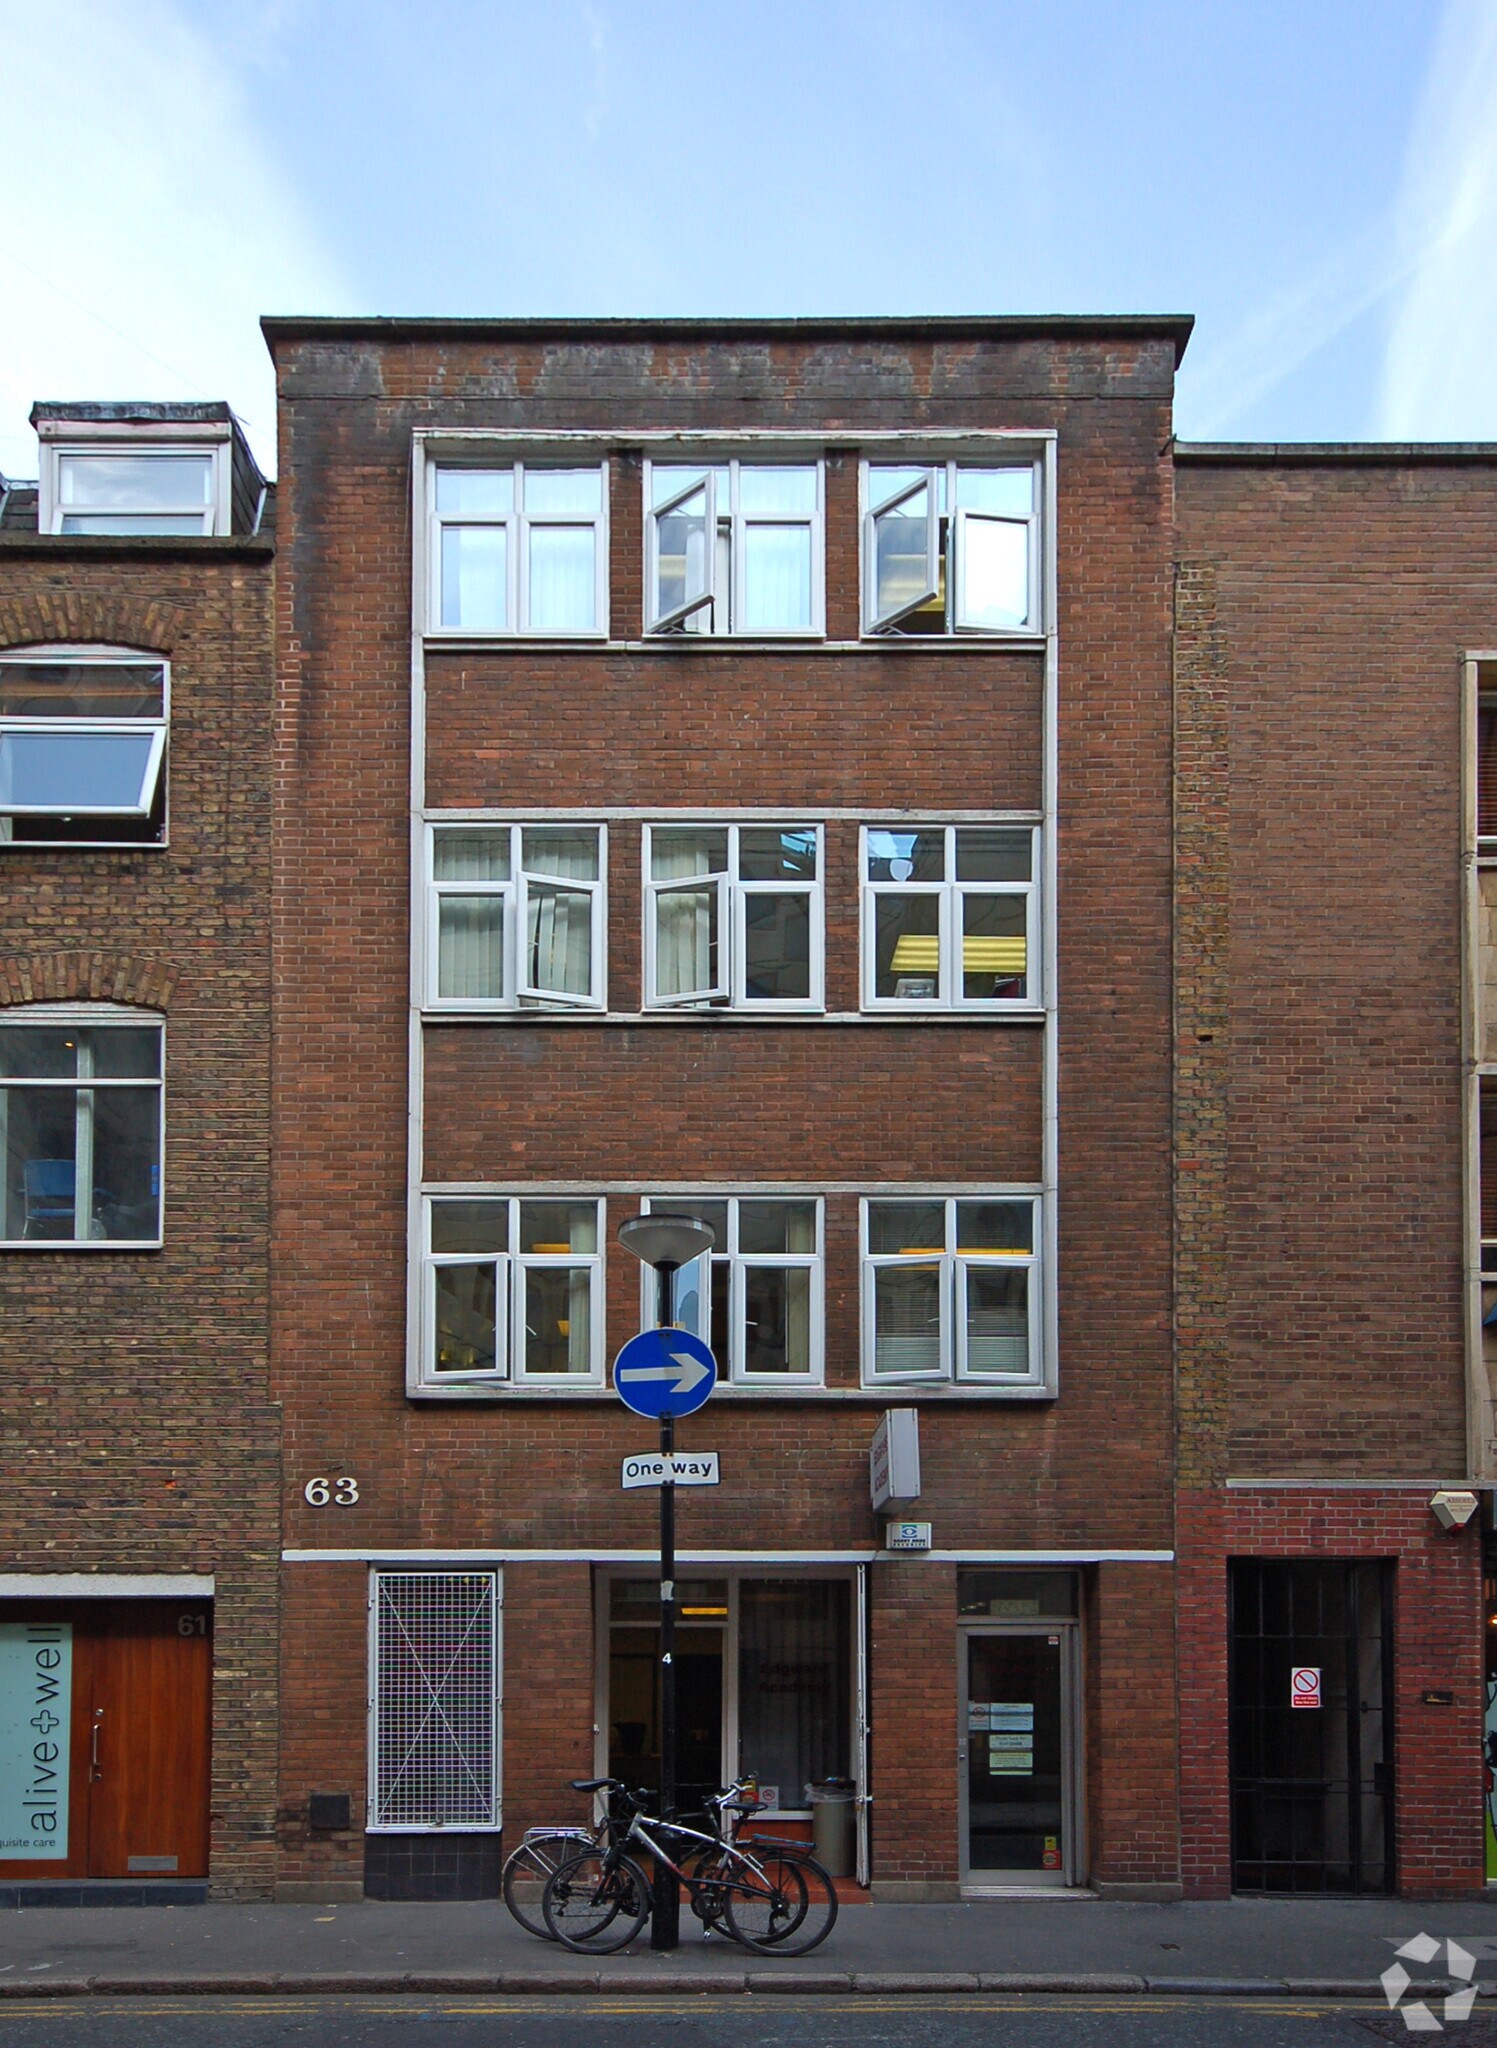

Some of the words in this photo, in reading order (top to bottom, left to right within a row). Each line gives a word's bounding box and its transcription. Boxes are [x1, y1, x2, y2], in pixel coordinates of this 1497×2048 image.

[626, 1462, 664, 1478] One
[671, 1462, 712, 1477] way
[304, 1477, 360, 1506] 63
[177, 1615, 206, 1636] 61
[661, 1652, 672, 1665] 4
[33, 1839, 56, 1847] care
